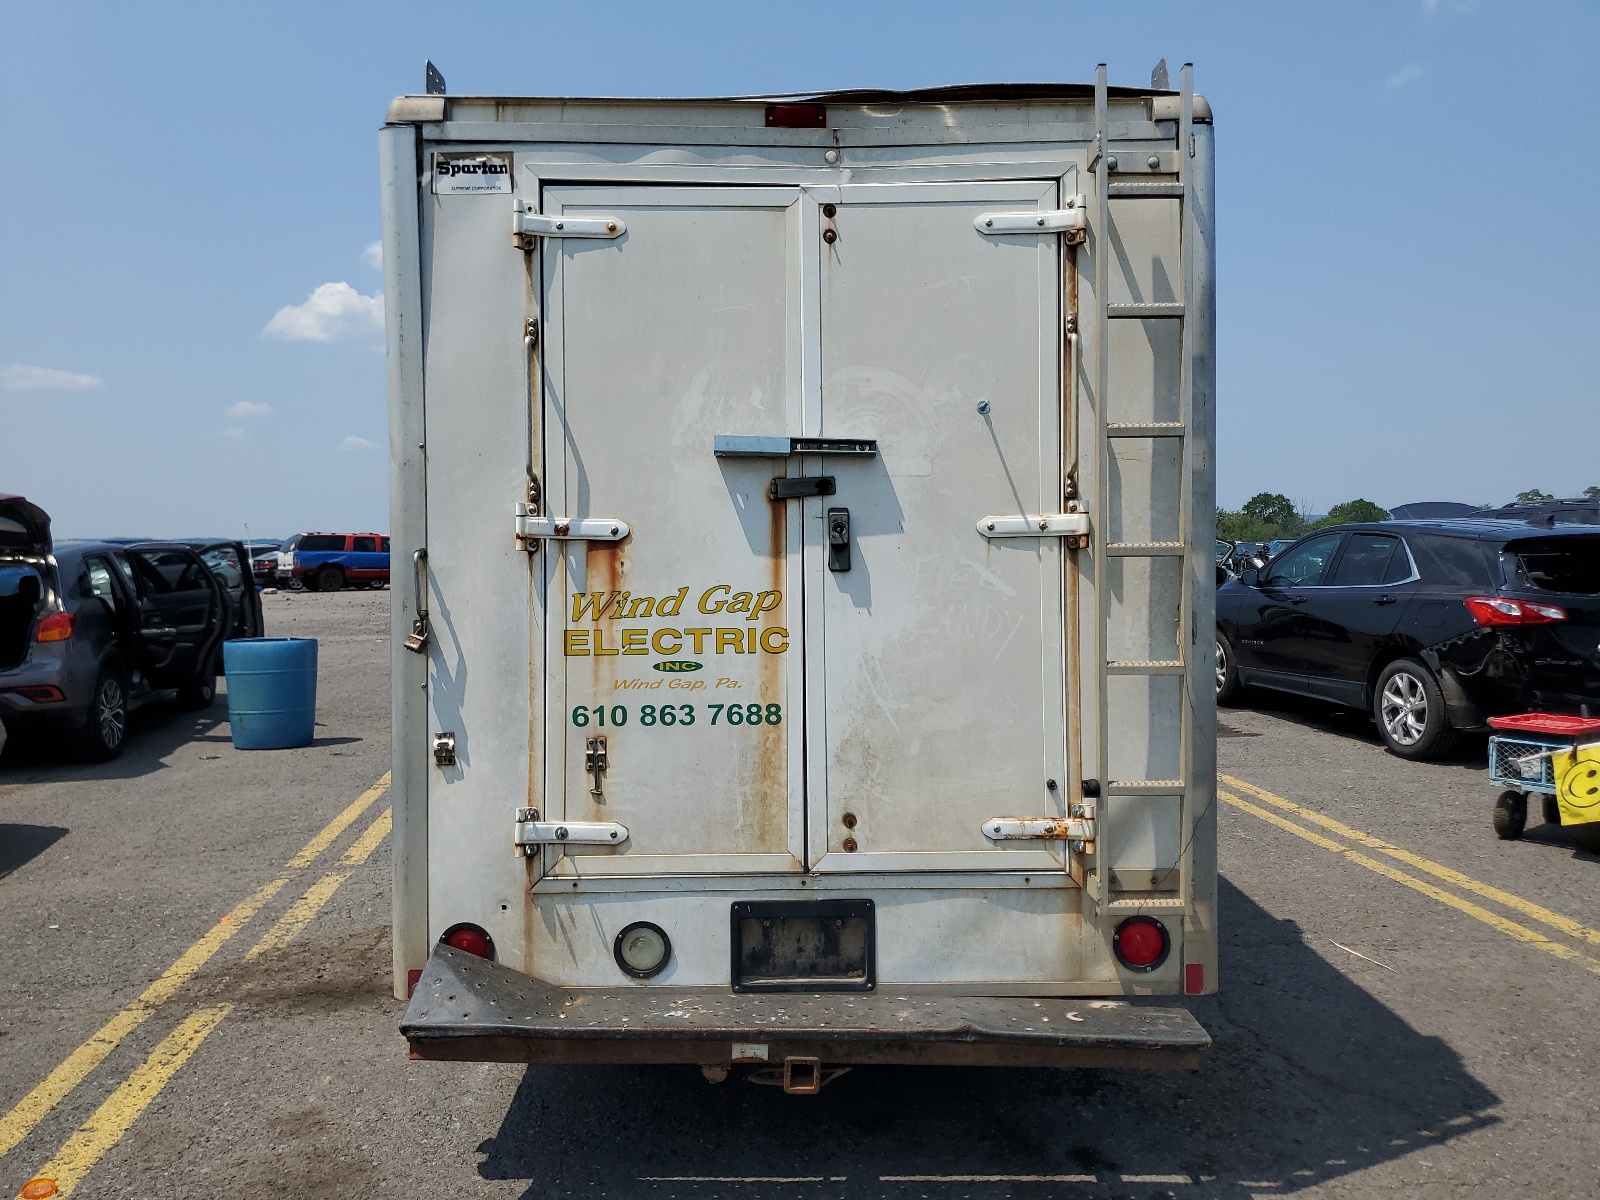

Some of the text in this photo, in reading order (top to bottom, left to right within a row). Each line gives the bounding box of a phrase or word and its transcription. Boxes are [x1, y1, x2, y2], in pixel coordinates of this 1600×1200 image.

[436, 161, 508, 177] Spartan
[572, 584, 783, 622] Wind Gap
[563, 627, 790, 656] ELECTRIC
[658, 662, 697, 672] INC
[613, 678, 743, 692] Wind Gap, Pa.
[571, 703, 783, 728] 610 863 7688
